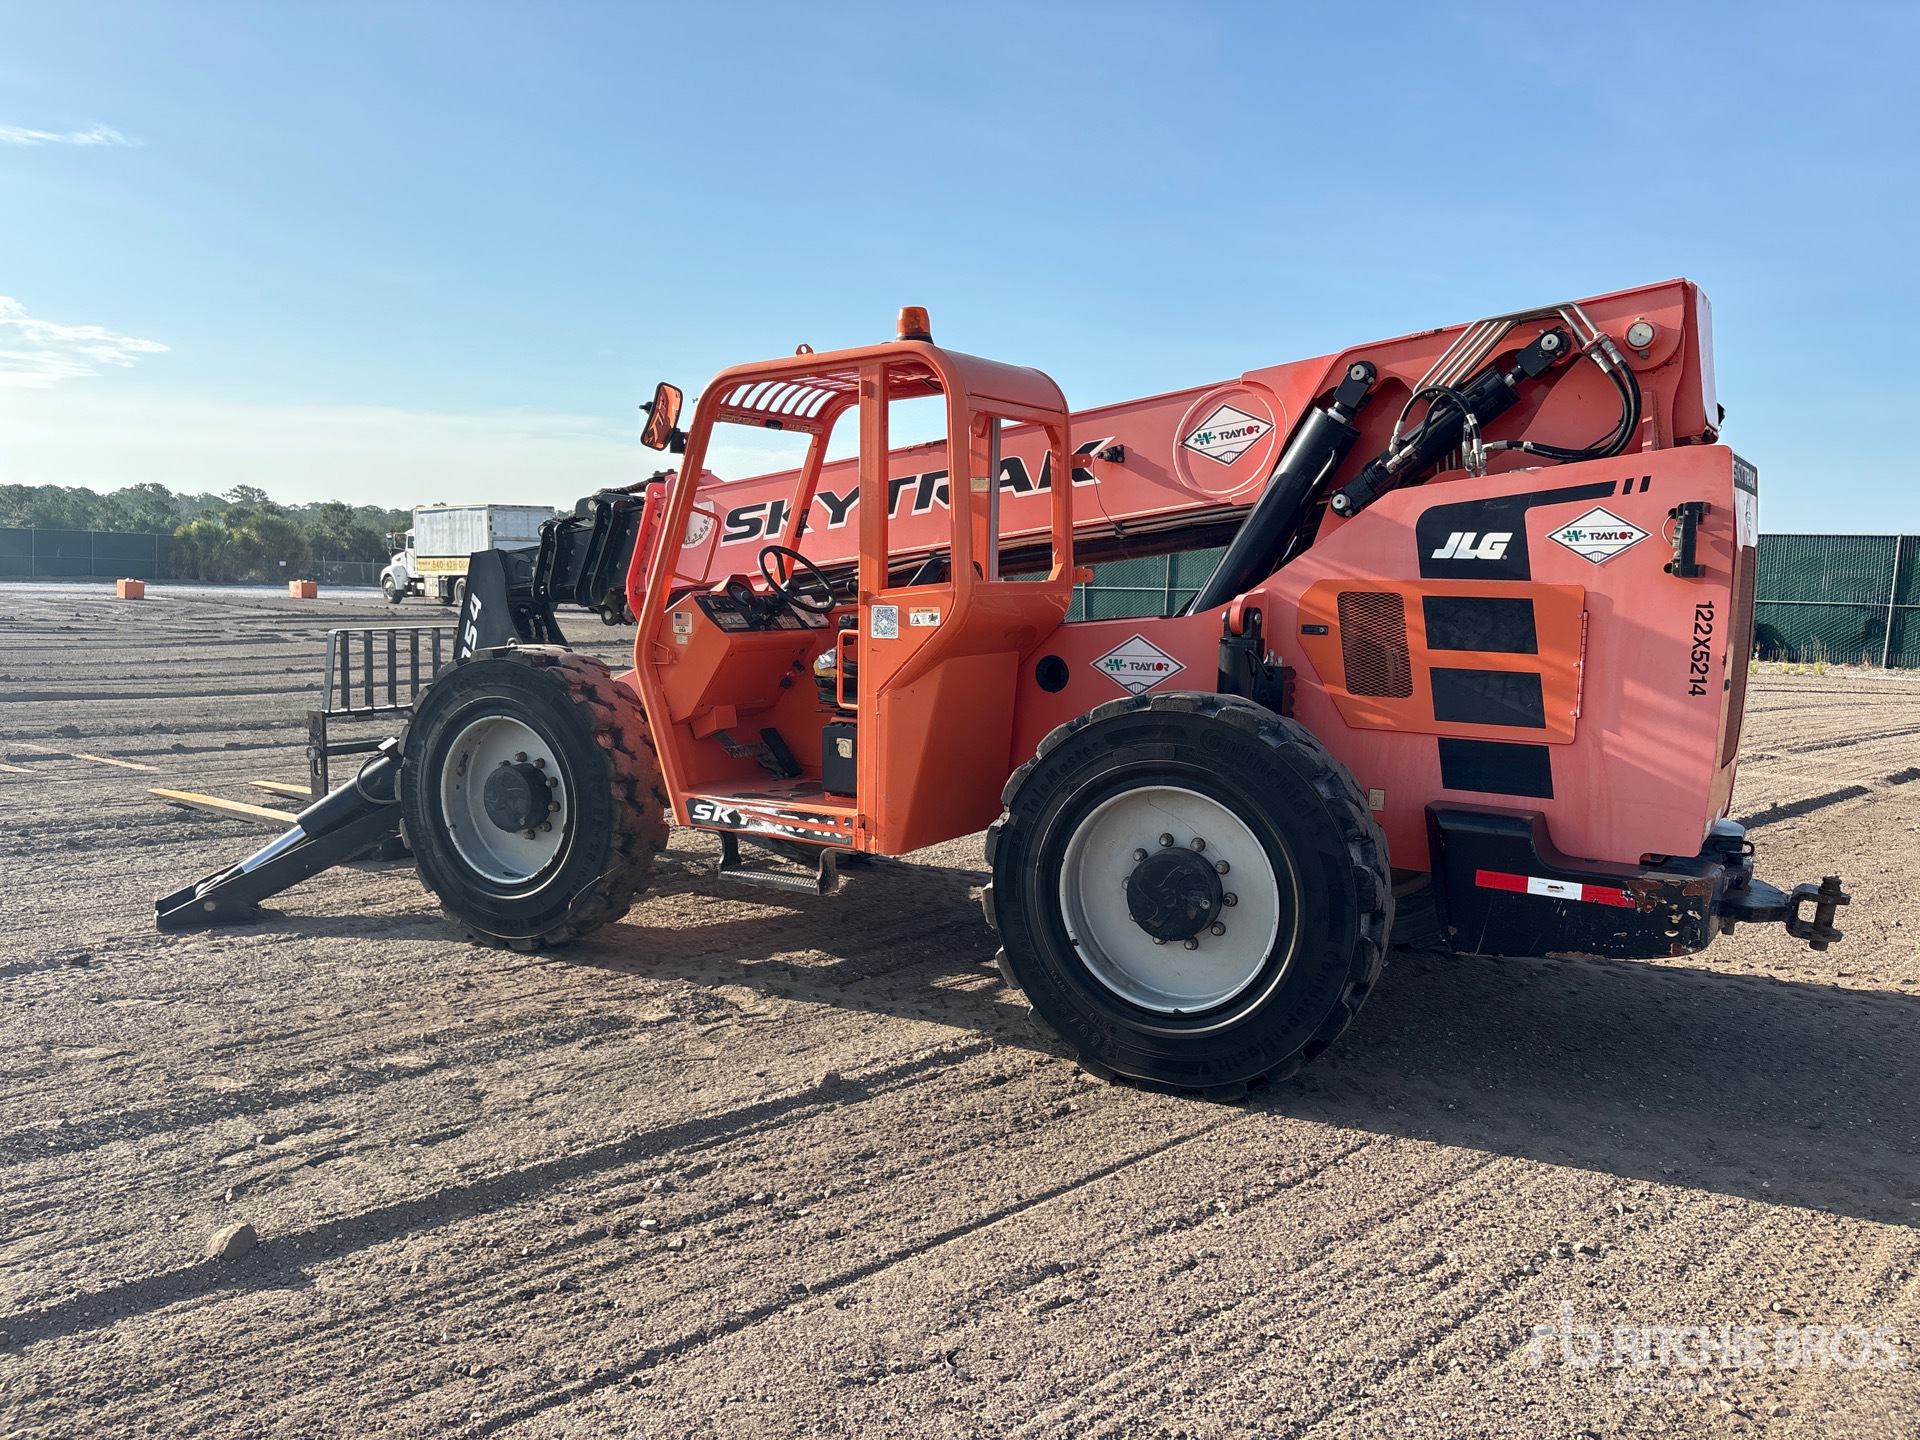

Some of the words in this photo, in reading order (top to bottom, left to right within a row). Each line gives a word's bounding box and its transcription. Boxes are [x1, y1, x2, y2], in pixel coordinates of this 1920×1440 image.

[1218, 425, 1261, 441] TRAYLOR
[721, 437, 1113, 547] SKYTRAK
[1431, 531, 1513, 560] JLG
[1588, 531, 1635, 540] TRAYLOR
[1129, 661, 1170, 672] TRAYLOR
[1688, 600, 1715, 697] 122X5214
[1022, 742, 1099, 814] TeleMaster
[1199, 728, 1319, 819] Continental
